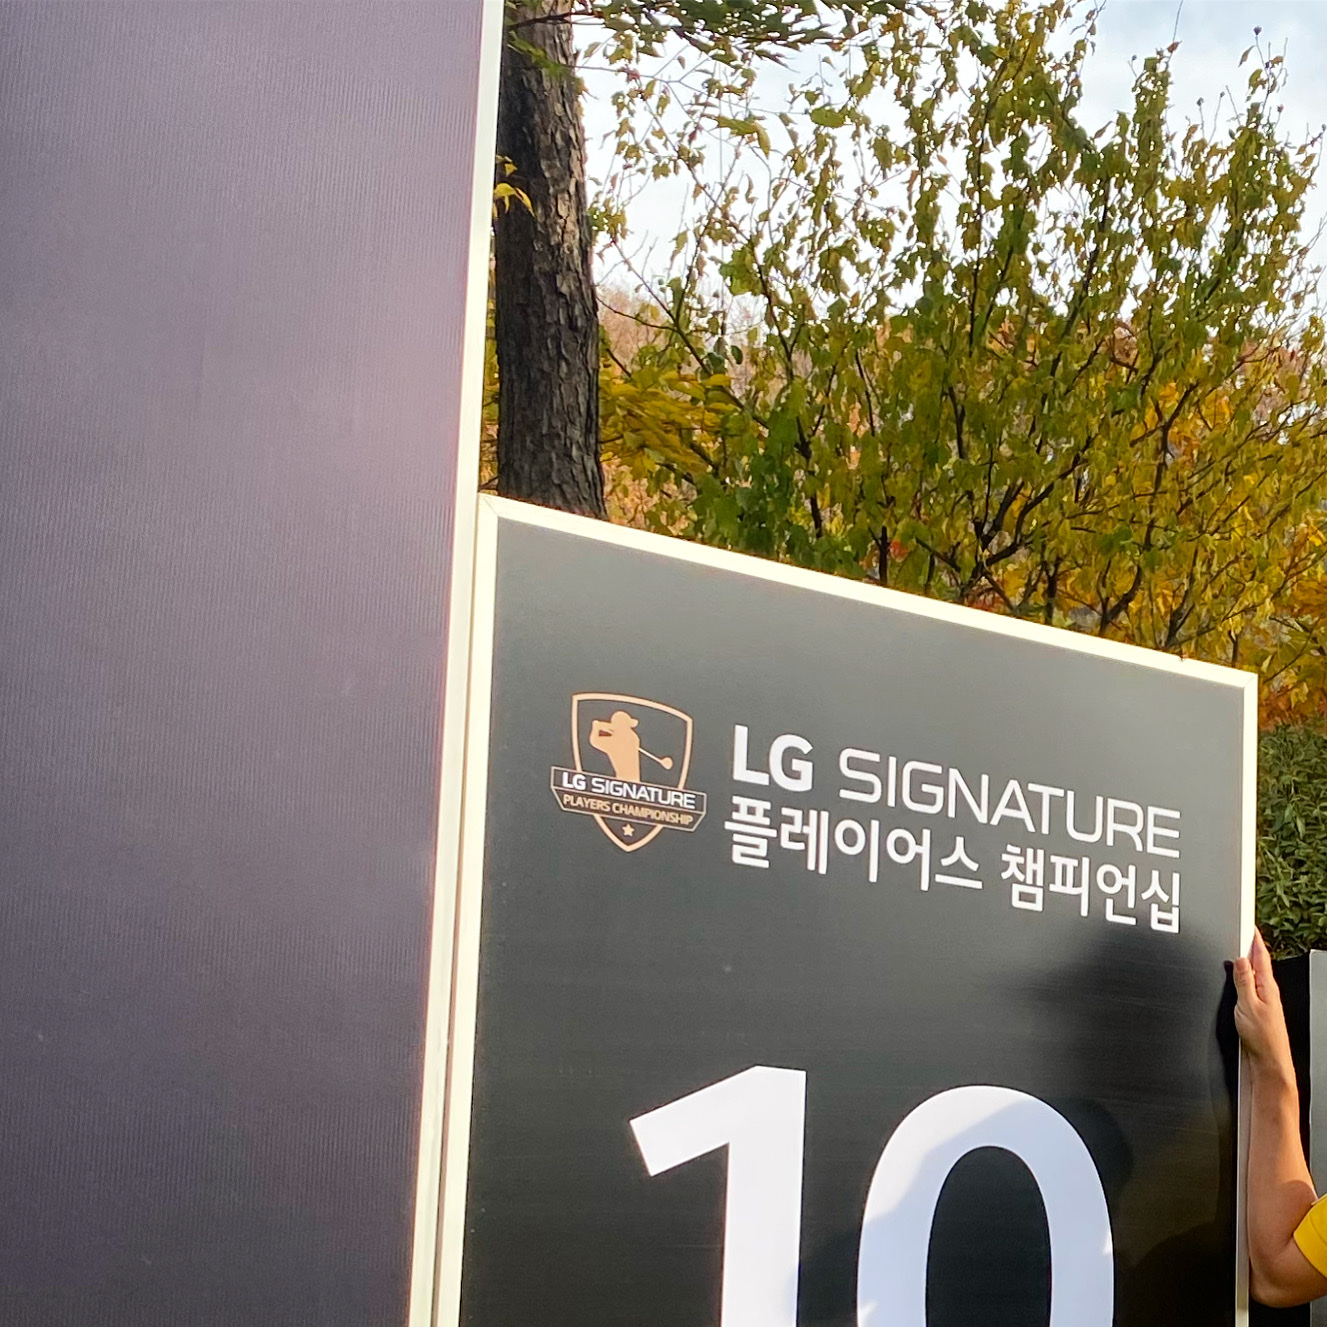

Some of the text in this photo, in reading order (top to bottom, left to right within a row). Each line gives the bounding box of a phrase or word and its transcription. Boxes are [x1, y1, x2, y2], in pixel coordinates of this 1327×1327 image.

[562, 771, 697, 810] LG SIGNATURE
[563, 793, 694, 826] PLAYERS CHAMPIONSHIP
[732, 724, 1181, 859] LG SIGNATURE
[724, 795, 1181, 934] 플레이어스 챔피언십
